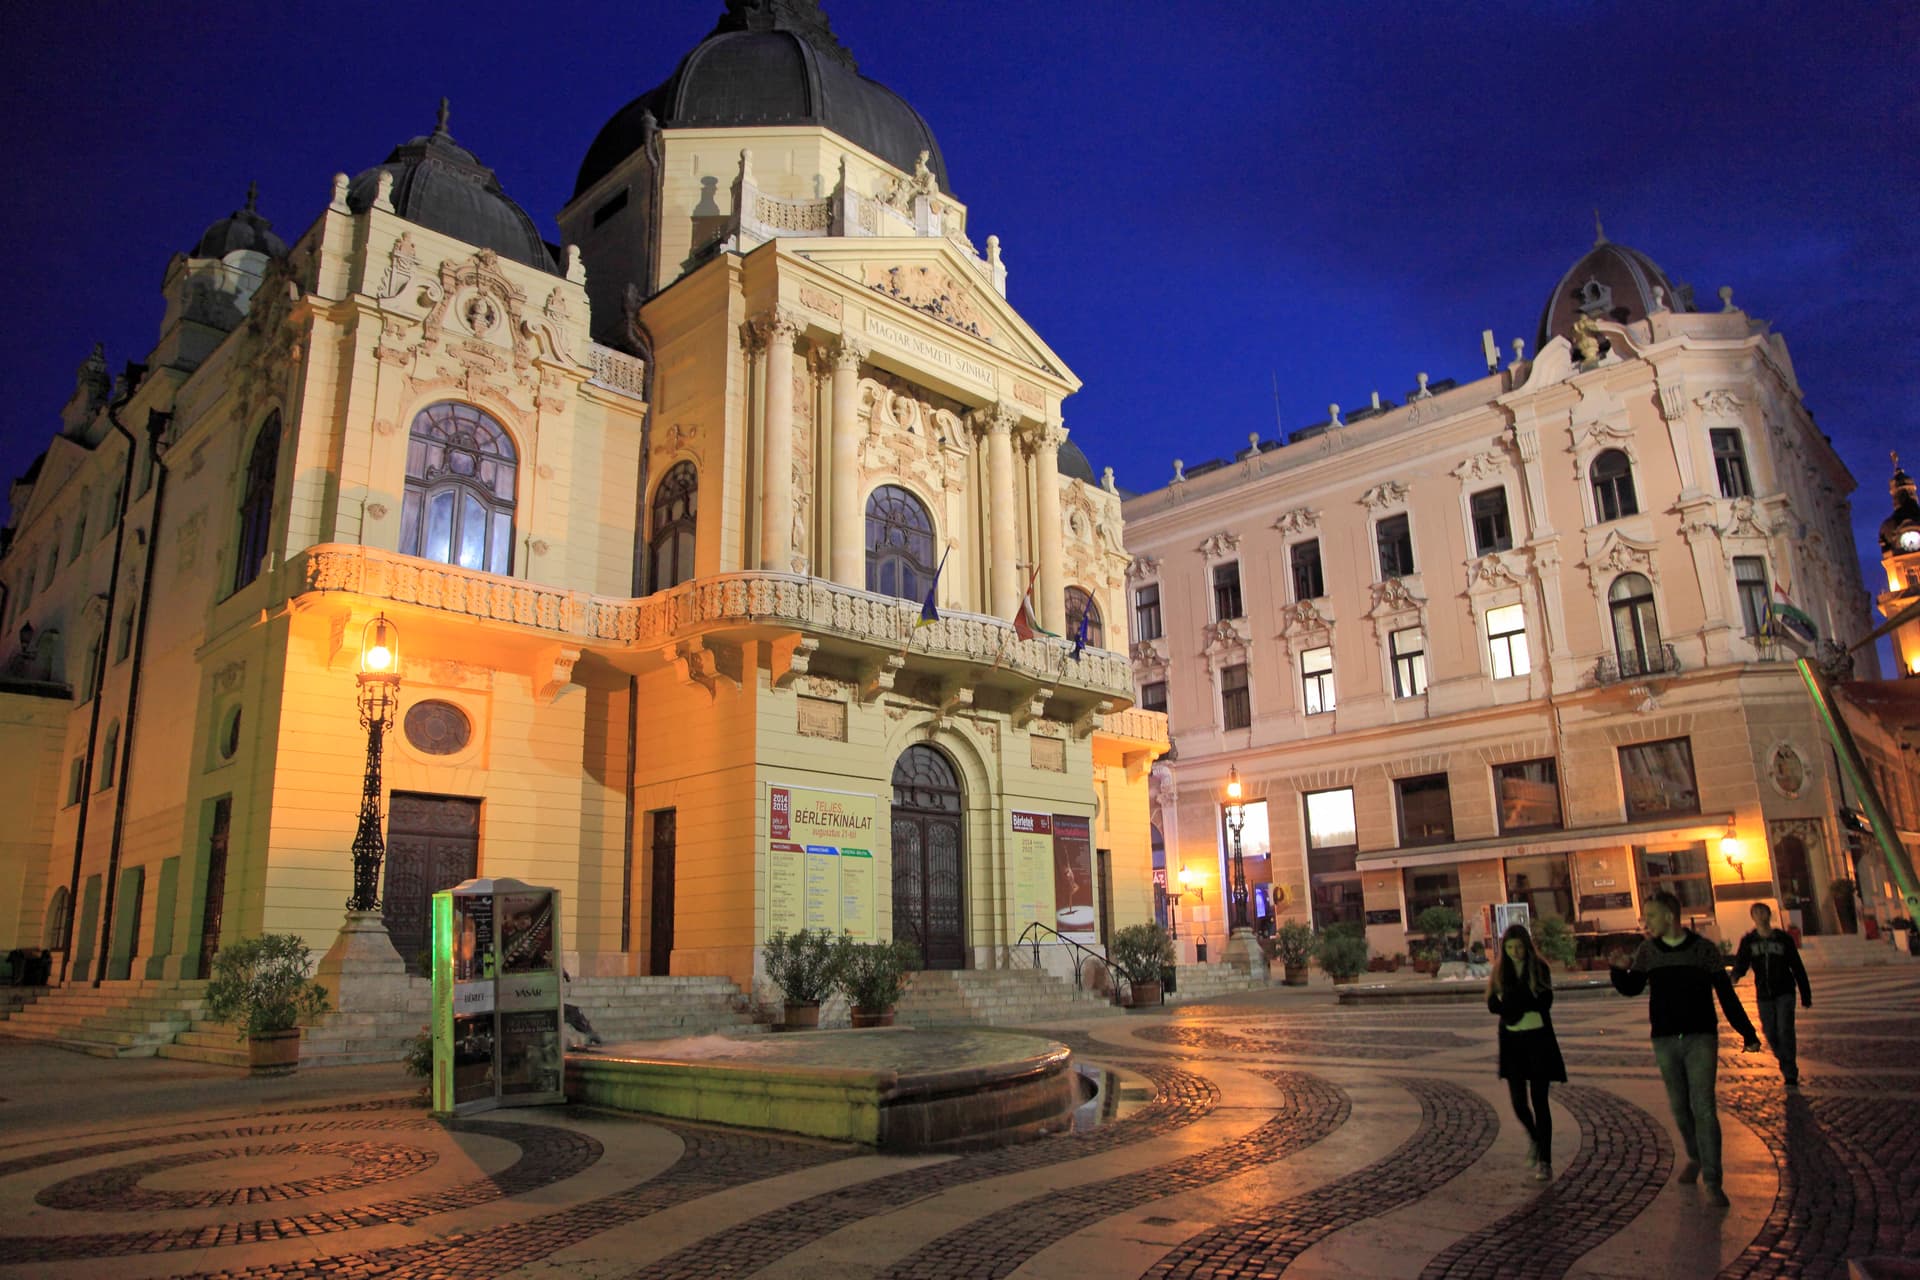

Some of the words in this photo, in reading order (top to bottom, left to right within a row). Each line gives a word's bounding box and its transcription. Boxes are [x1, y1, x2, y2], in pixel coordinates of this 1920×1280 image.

[869, 319, 910, 349] MAGYAR
[912, 337, 952, 366] NEMZETI
[773, 794, 788, 803] 2014
[773, 802, 788, 811] 2015
[795, 808, 873, 830] BÉRLETKÍNÁLAT
